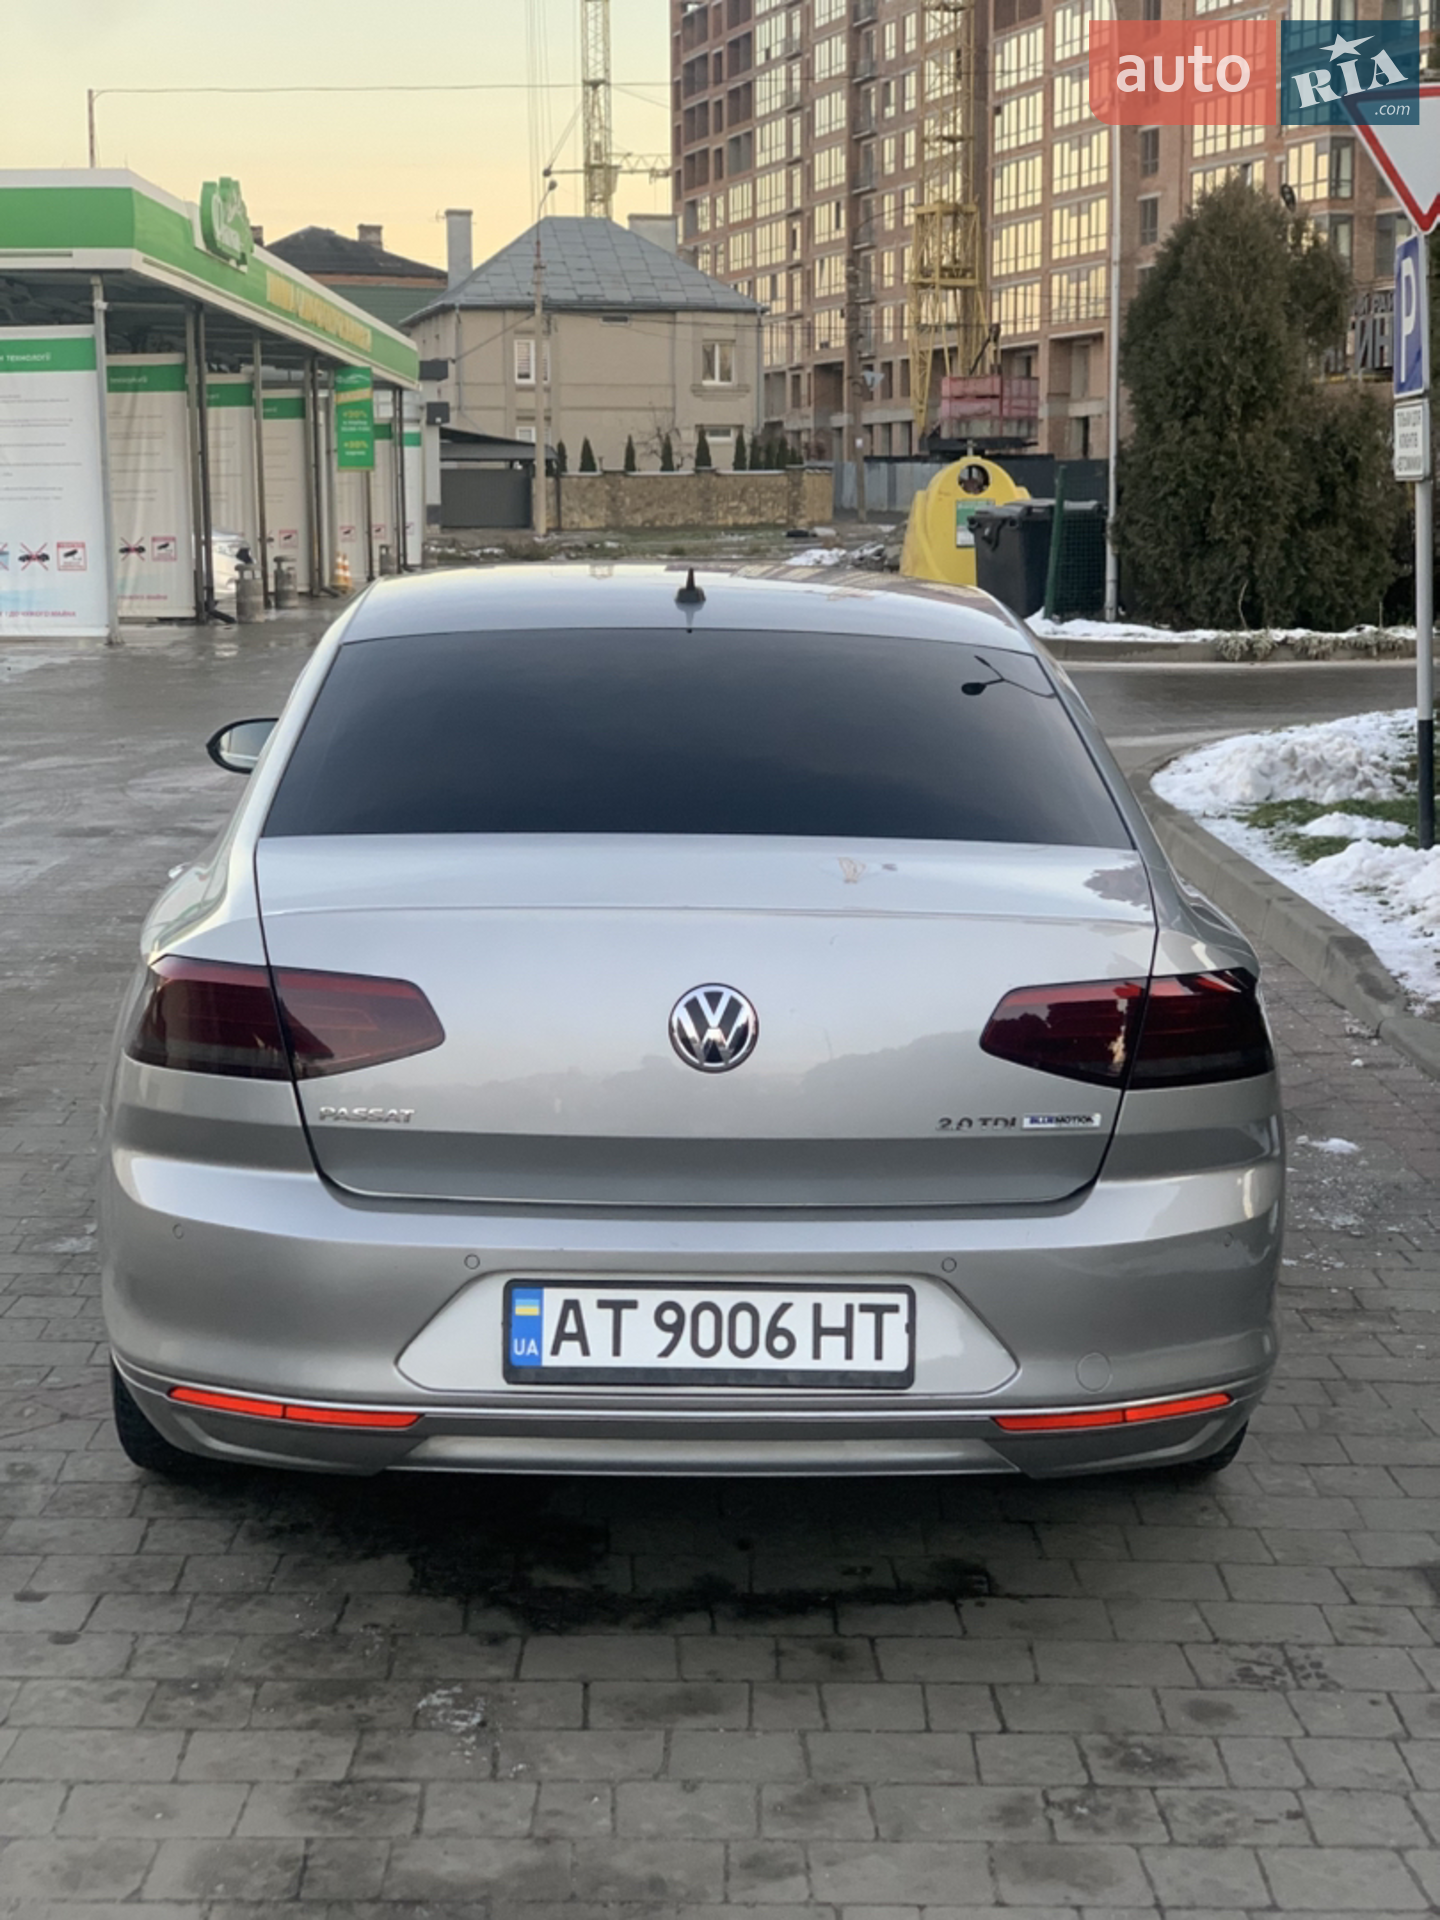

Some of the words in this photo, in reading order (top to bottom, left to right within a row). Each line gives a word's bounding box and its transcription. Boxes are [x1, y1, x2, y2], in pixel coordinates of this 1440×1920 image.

[1401, 257, 1416, 383] P
[319, 1107, 415, 1123] PASSAT
[936, 1117, 973, 1131] 2.0
[977, 1117, 1016, 1131] TDI
[653, 1300, 797, 1359] 9006
[513, 1339, 539, 1356] UA
